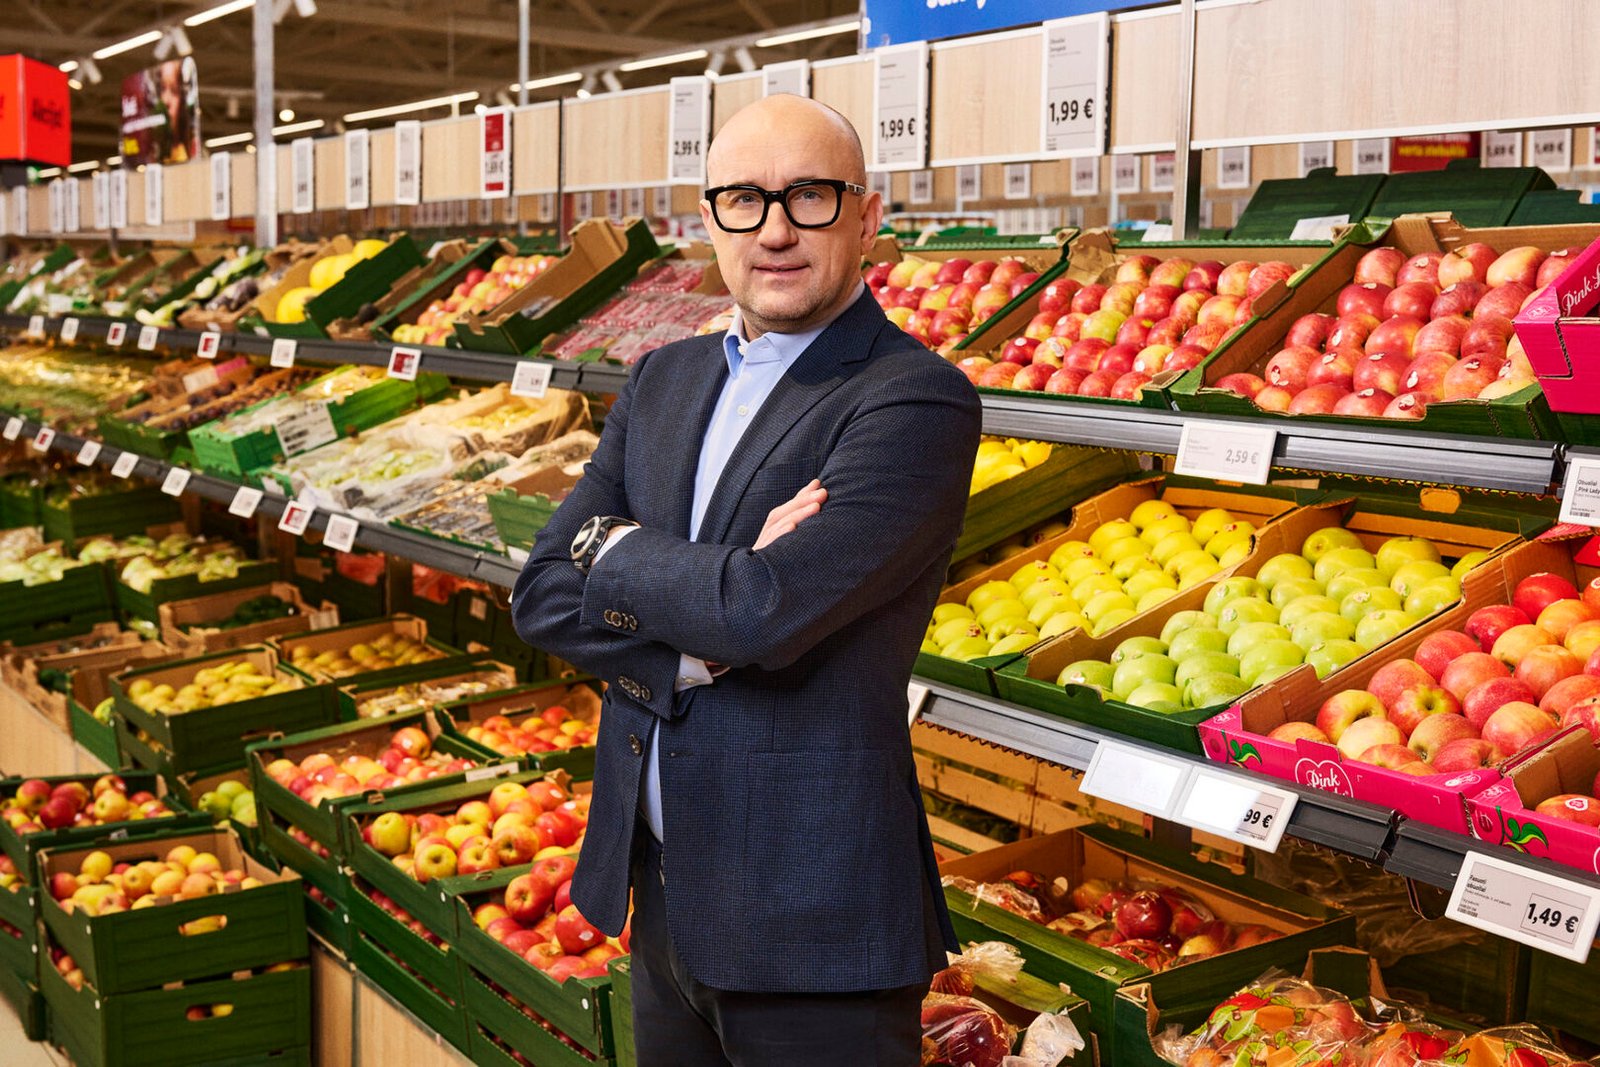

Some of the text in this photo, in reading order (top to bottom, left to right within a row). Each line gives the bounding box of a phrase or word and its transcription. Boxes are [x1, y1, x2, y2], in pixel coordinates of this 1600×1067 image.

[1049, 98, 1094, 125] 1,99 €
[880, 118, 915, 141] 1,99 €
[1562, 276, 1592, 317] Pink
[1225, 449, 1259, 465] 2,59 €
[1305, 768, 1340, 788] Pink
[1261, 814, 1273, 829] €
[1527, 903, 1579, 934] 1,49 €
